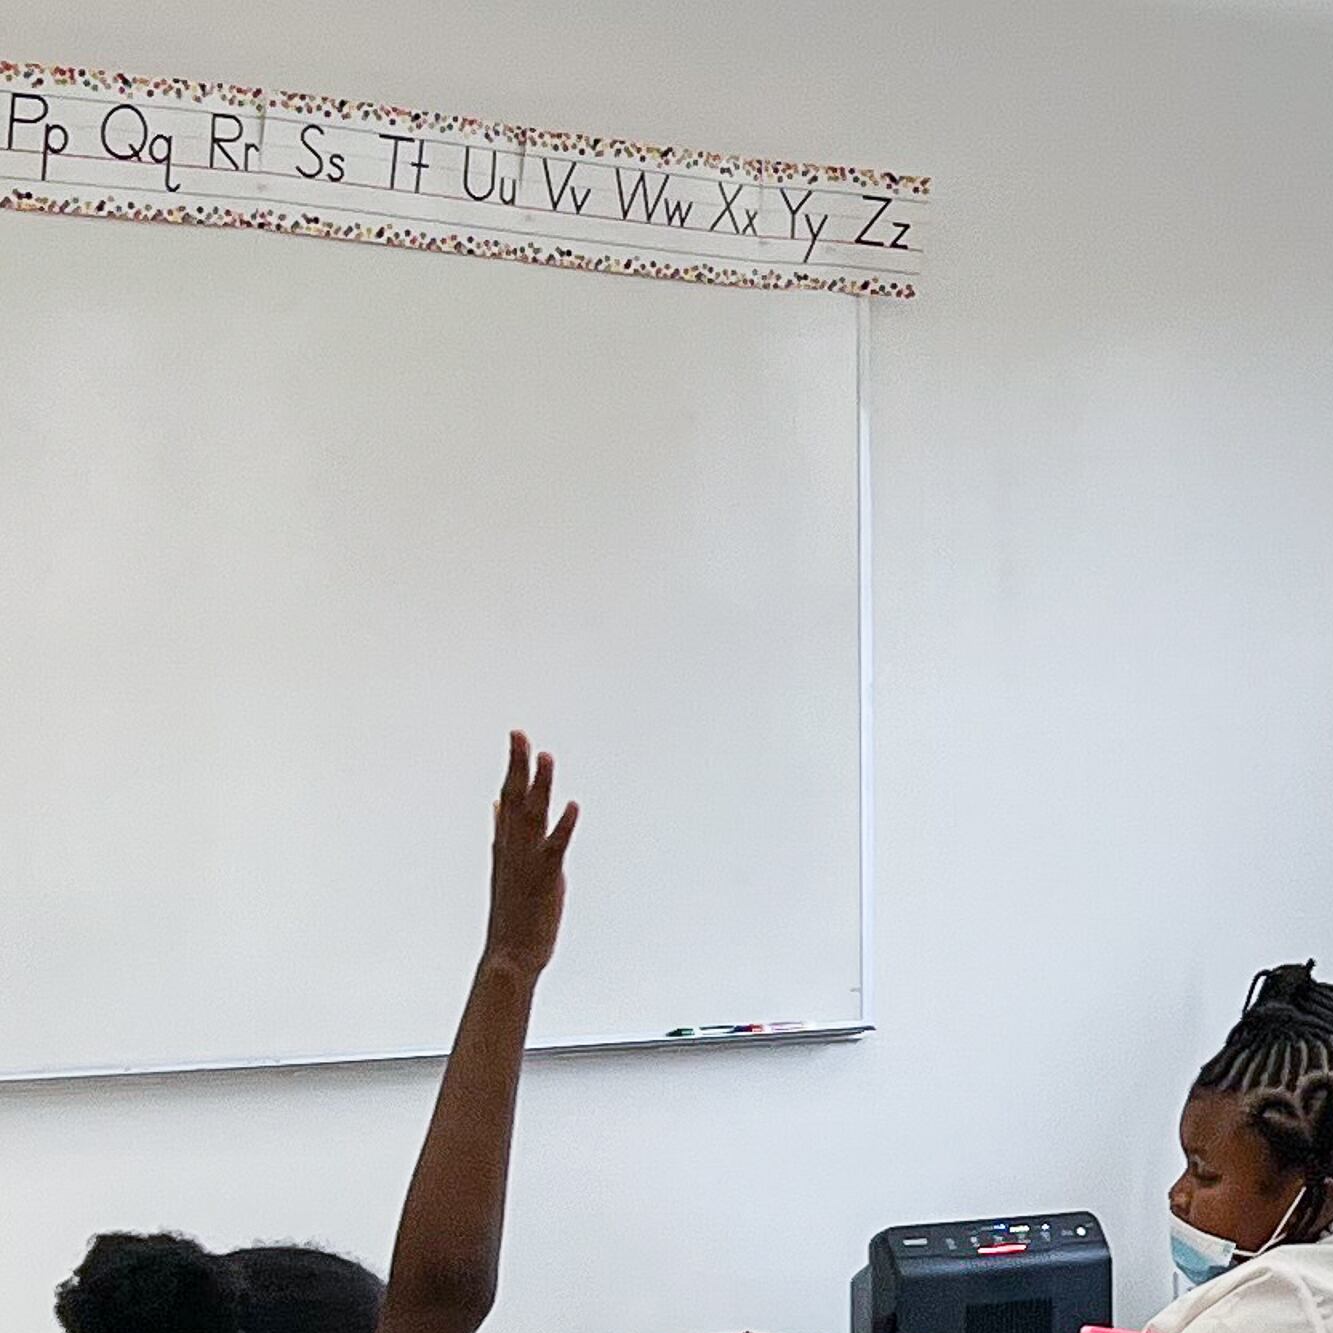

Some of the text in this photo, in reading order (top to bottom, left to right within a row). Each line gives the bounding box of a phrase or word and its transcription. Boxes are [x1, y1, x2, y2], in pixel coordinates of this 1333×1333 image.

[7, 92, 911, 263] Pp Qq Rr Ss Tt Uu Vv Ww Xx Yy Zz
